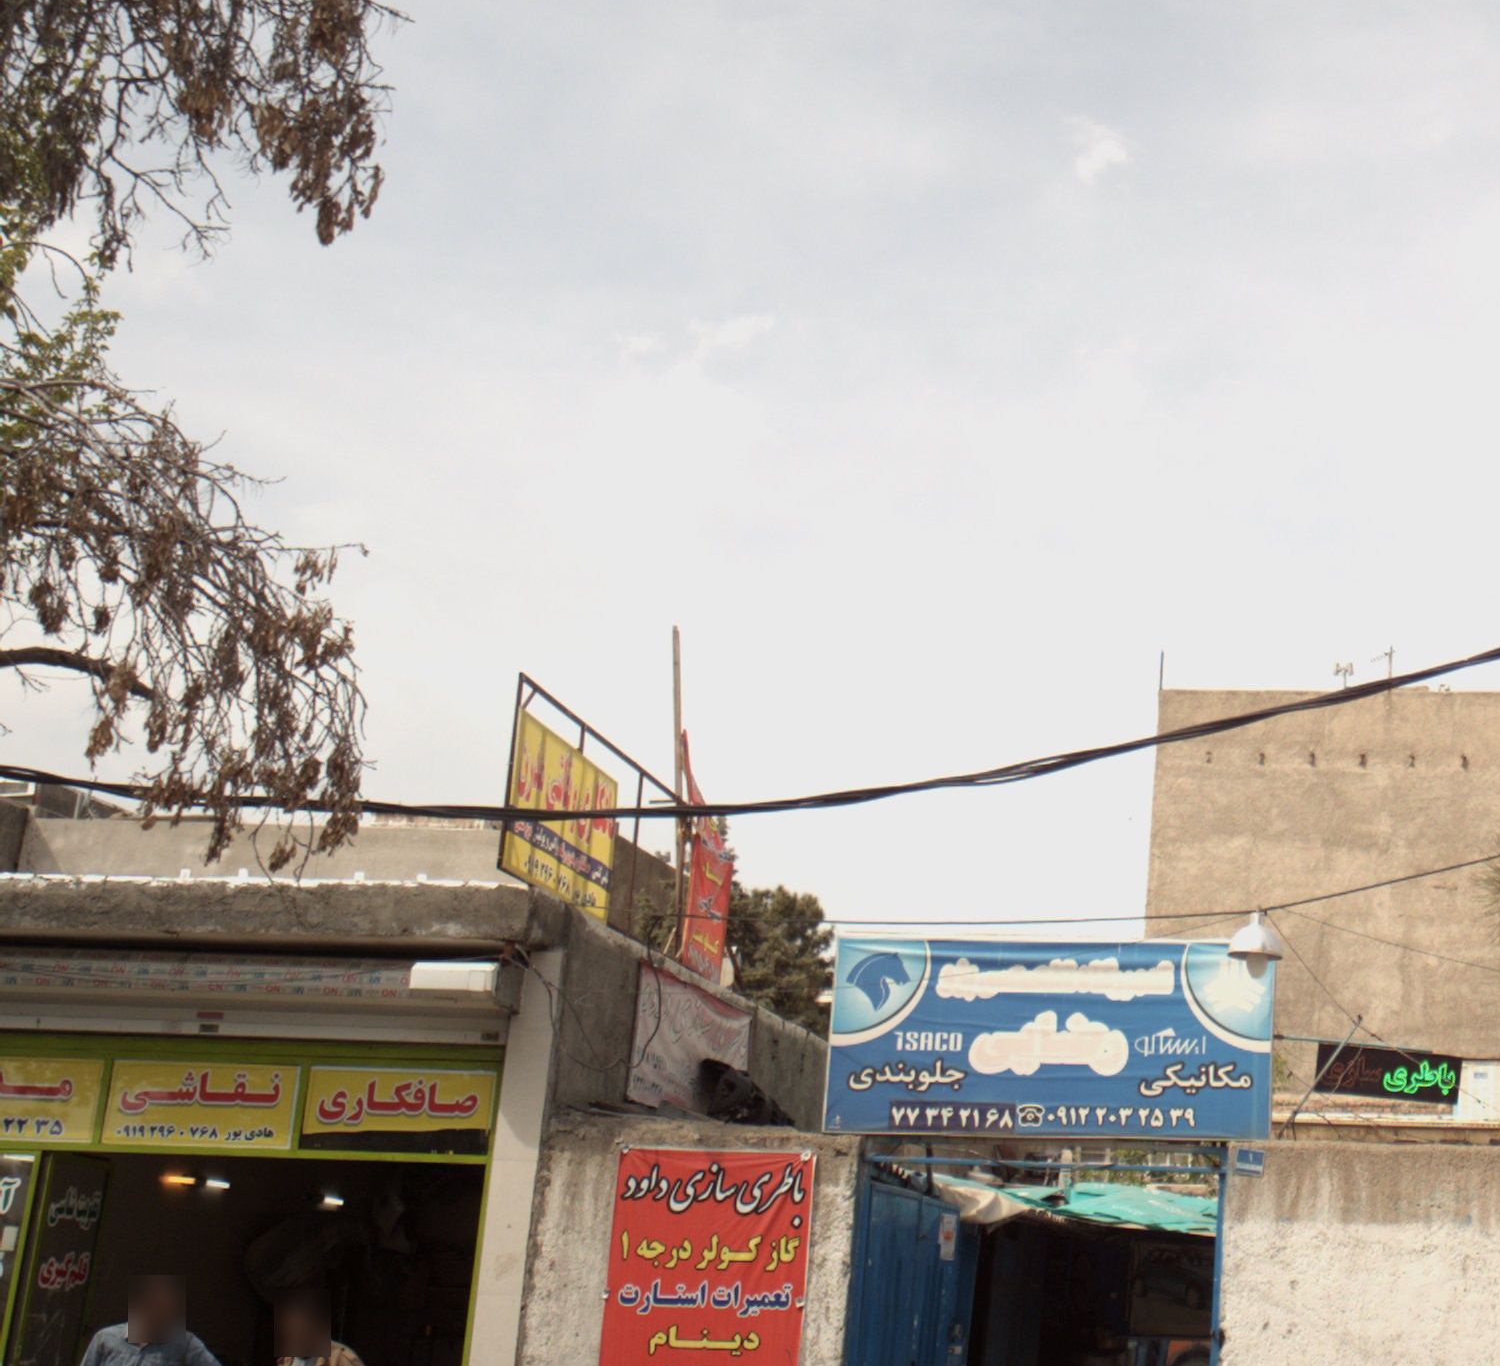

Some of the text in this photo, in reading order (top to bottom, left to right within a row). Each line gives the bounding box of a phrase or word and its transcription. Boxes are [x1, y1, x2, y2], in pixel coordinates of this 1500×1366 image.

[119, 1070, 282, 1115] نقاشی
[848, 1058, 967, 1091] جلوبندی
[1138, 1061, 1253, 1097] مکانیکی
[1383, 1059, 1456, 1096] باطری
[317, 1077, 480, 1124] صافکاری
[620, 1163, 806, 1228] باطری سازی داود
[635, 1237, 693, 1270] درجه
[695, 1234, 762, 1271] کولر
[764, 1235, 800, 1272] گاز
[618, 1278, 792, 1318] تعمیرات استارت
[648, 1324, 761, 1356] دینام
